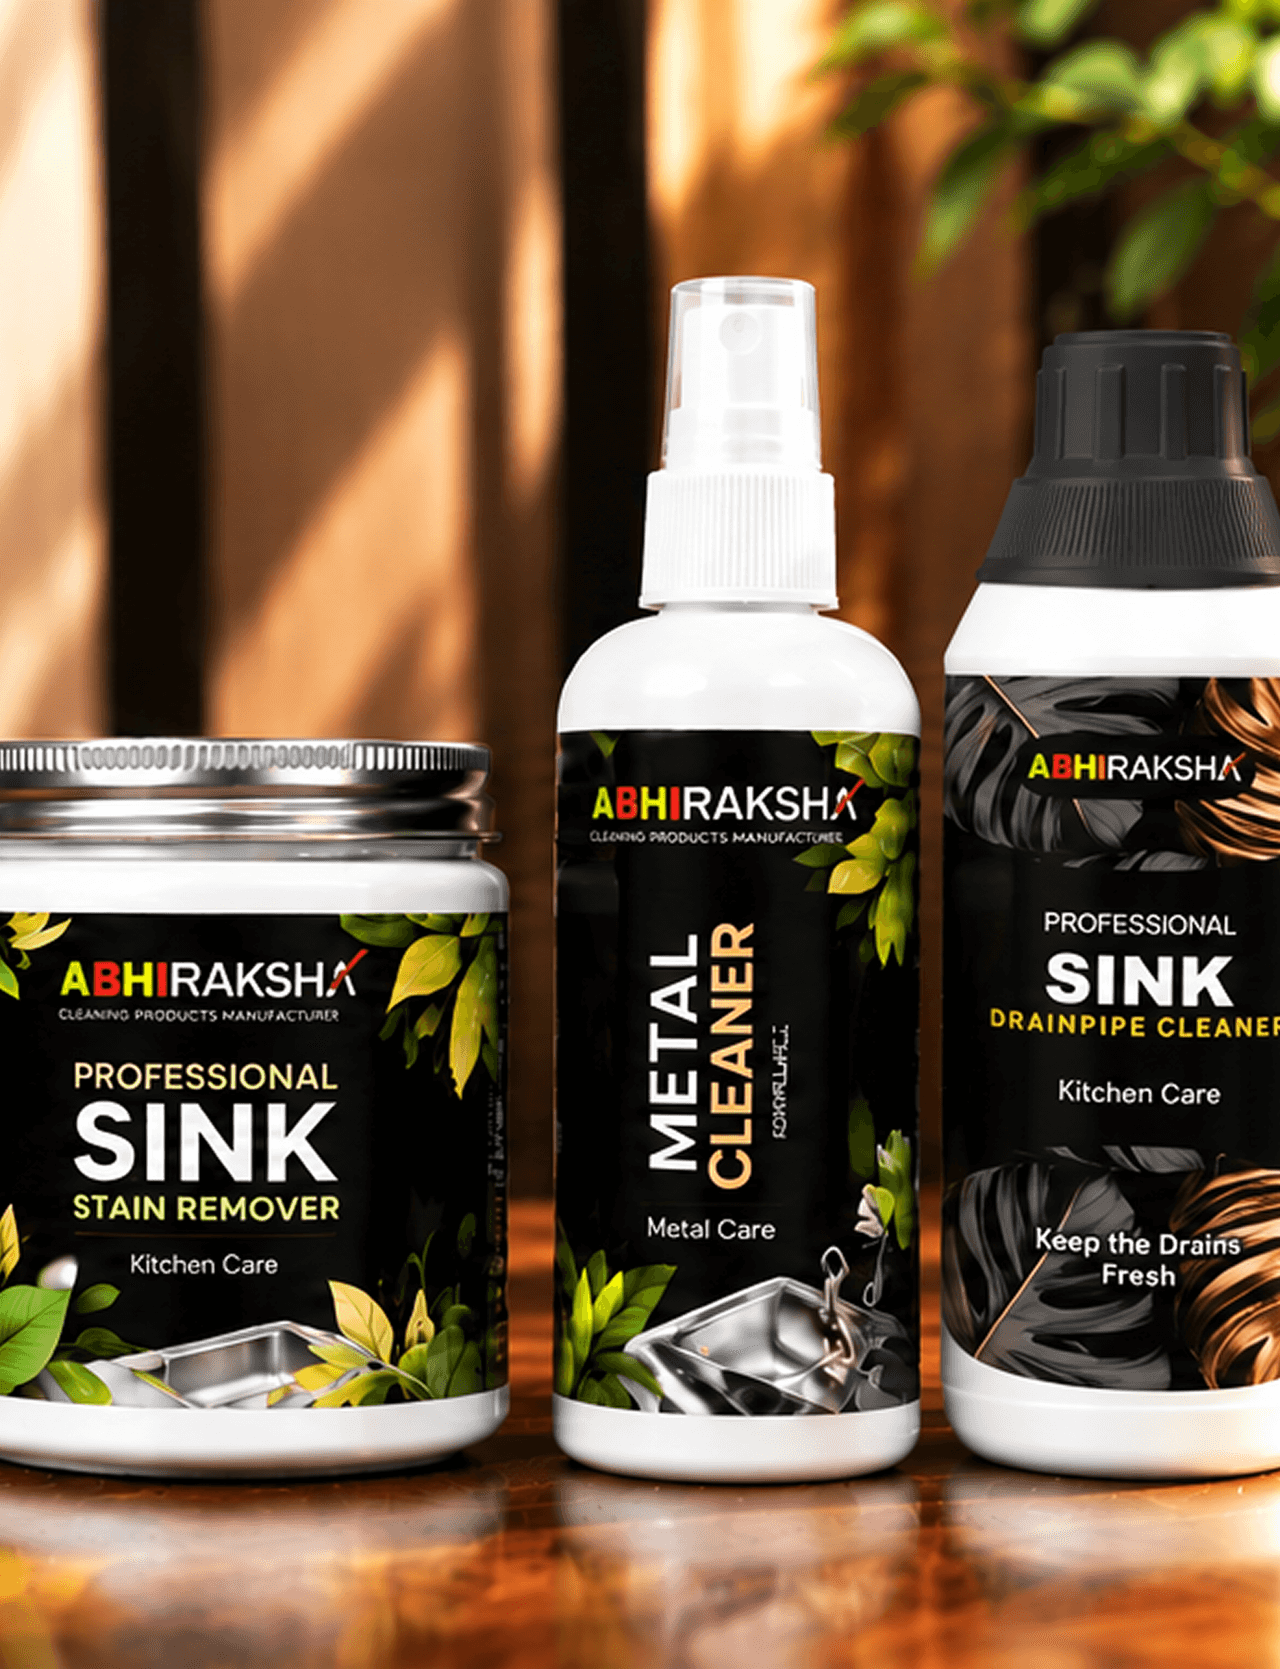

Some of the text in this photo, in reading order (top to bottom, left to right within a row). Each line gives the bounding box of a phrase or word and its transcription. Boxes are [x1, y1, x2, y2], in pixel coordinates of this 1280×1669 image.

[1029, 753, 1246, 782] ABHIRAKSHA
[592, 779, 864, 821] ABHIRAKSHA
[649, 831, 729, 844] PRODUCTS
[1044, 911, 1237, 936] PROFESSIONAL
[60, 949, 368, 998] ABHIRAKSHA
[1045, 952, 1234, 1007] SINK
[58, 1007, 129, 1022] CLEANING
[134, 1009, 218, 1022] PRODUCTS
[990, 1007, 1146, 1037] DRAINPIPE
[648, 934, 698, 1171] METAL
[707, 922, 755, 1190] CLEANER
[74, 1061, 339, 1091] PROFESSIONAL
[1058, 1079, 1221, 1105] Kitchen Care
[73, 1100, 339, 1183] SINK
[73, 1194, 340, 1222] STAIN REMOVER
[647, 1216, 776, 1240] Metal Care
[1036, 1227, 1241, 1258] Keep the Drains
[130, 1253, 279, 1275] Kitchen Care
[1102, 1263, 1176, 1286] Fresh
